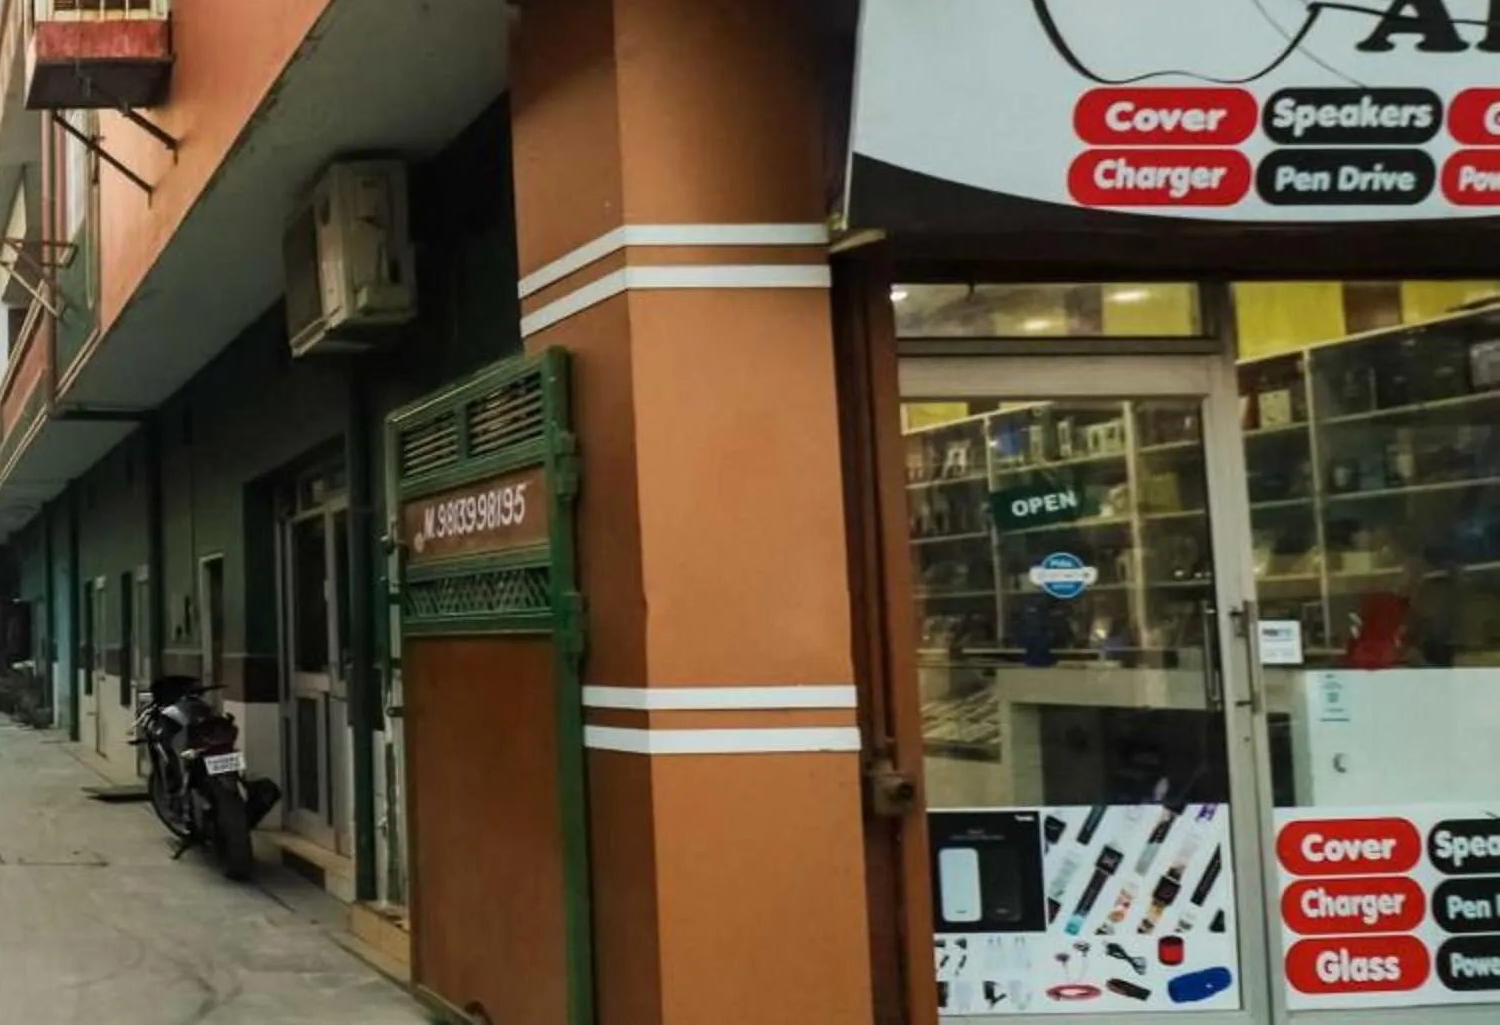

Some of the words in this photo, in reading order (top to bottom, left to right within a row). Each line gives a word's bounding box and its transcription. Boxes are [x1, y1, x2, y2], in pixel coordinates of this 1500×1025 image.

[1106, 102, 1228, 133] Cover
[1272, 95, 1434, 137] Speakers
[1093, 160, 1228, 198] Charger
[1274, 165, 1331, 192] Pen
[1337, 163, 1417, 192] Drive
[1011, 490, 1078, 517] OPEN
[1301, 833, 1397, 863] Cover
[1301, 886, 1406, 926] Charger
[1446, 894, 1492, 919] Pen
[1315, 946, 1402, 984] Glass
